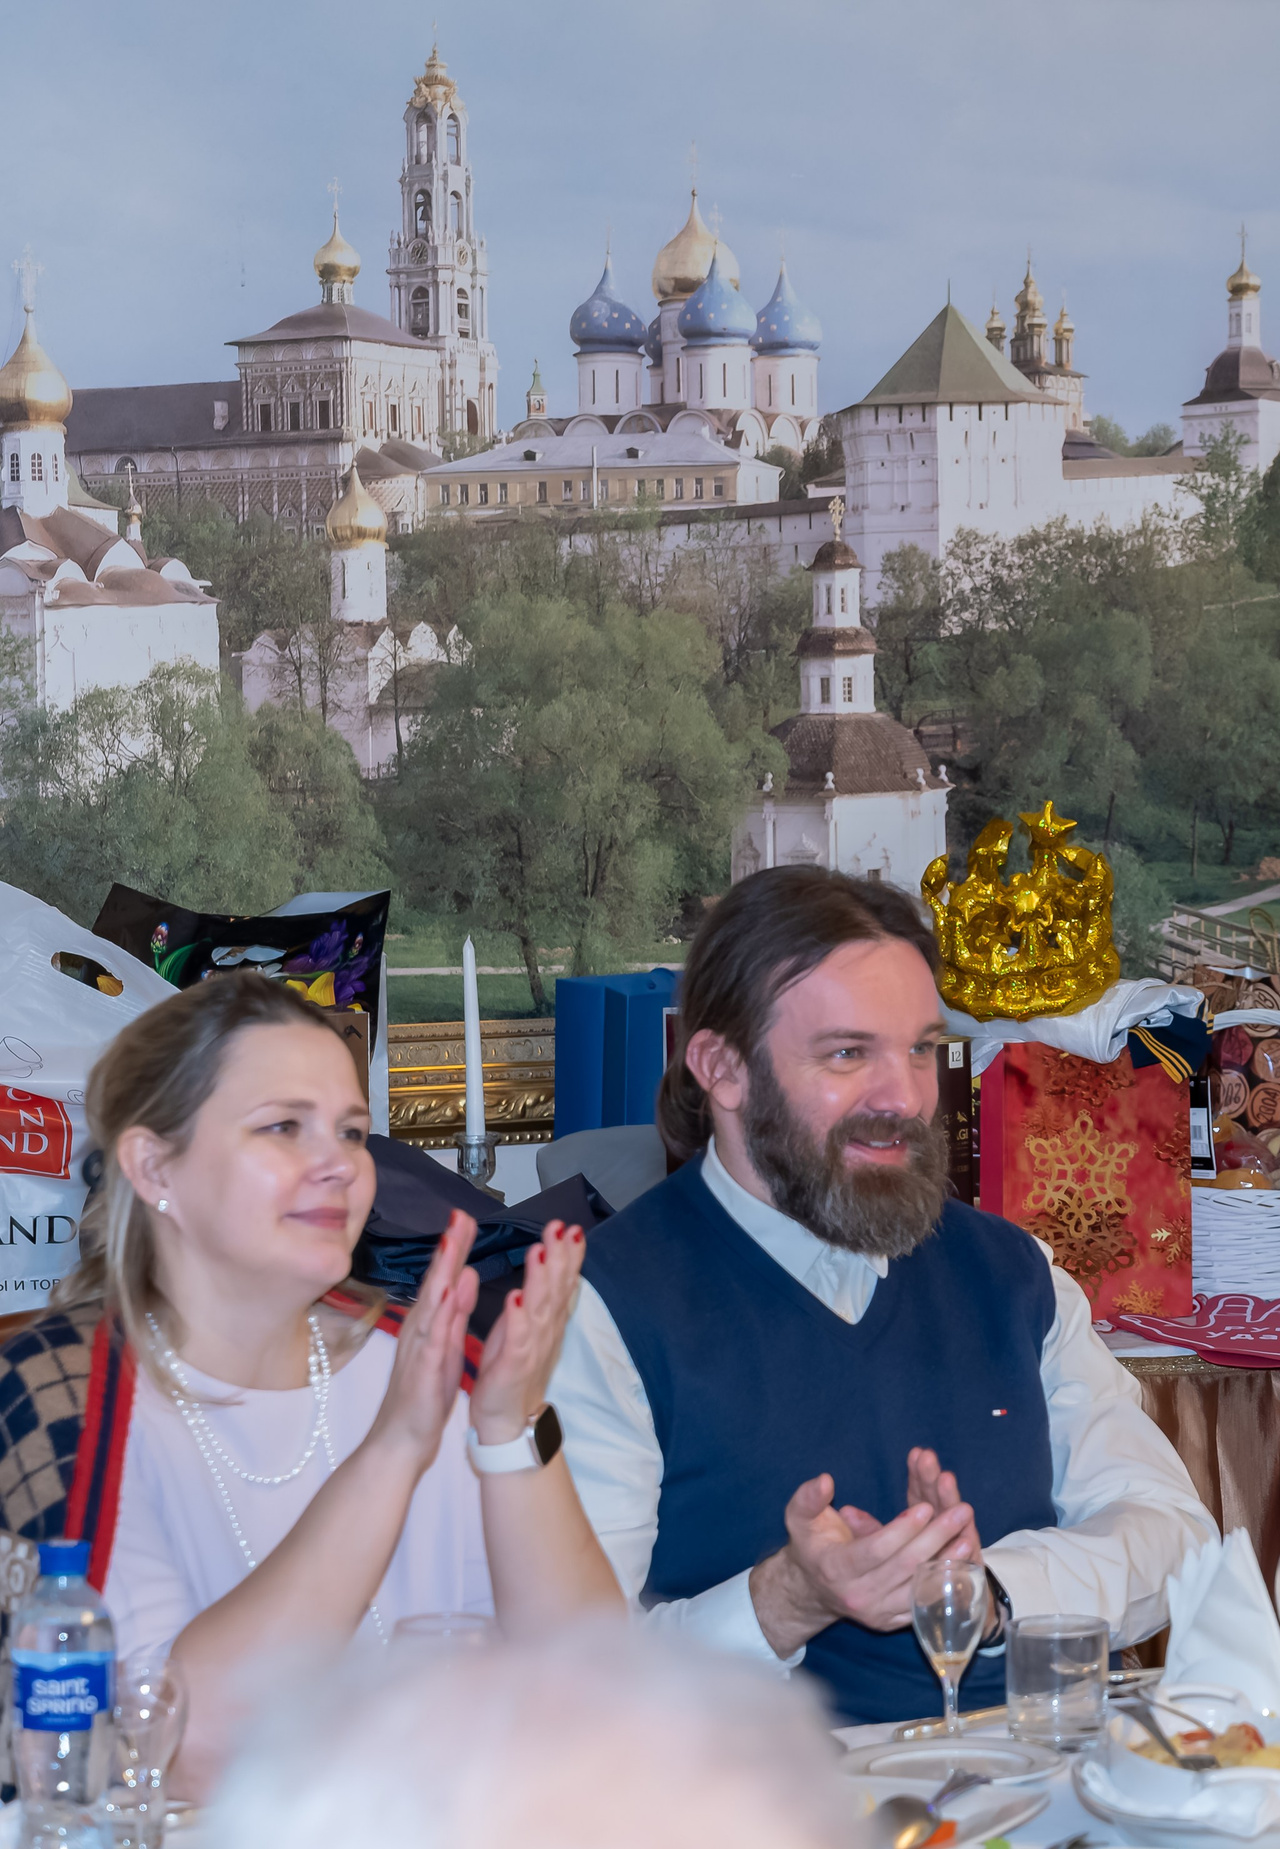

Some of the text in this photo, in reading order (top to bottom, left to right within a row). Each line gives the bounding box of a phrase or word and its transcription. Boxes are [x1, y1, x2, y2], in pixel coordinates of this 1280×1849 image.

[951, 1050, 961, 1063] 12
[1256, 1089, 1279, 1123] 2004
[0, 1215, 77, 1245] ND
